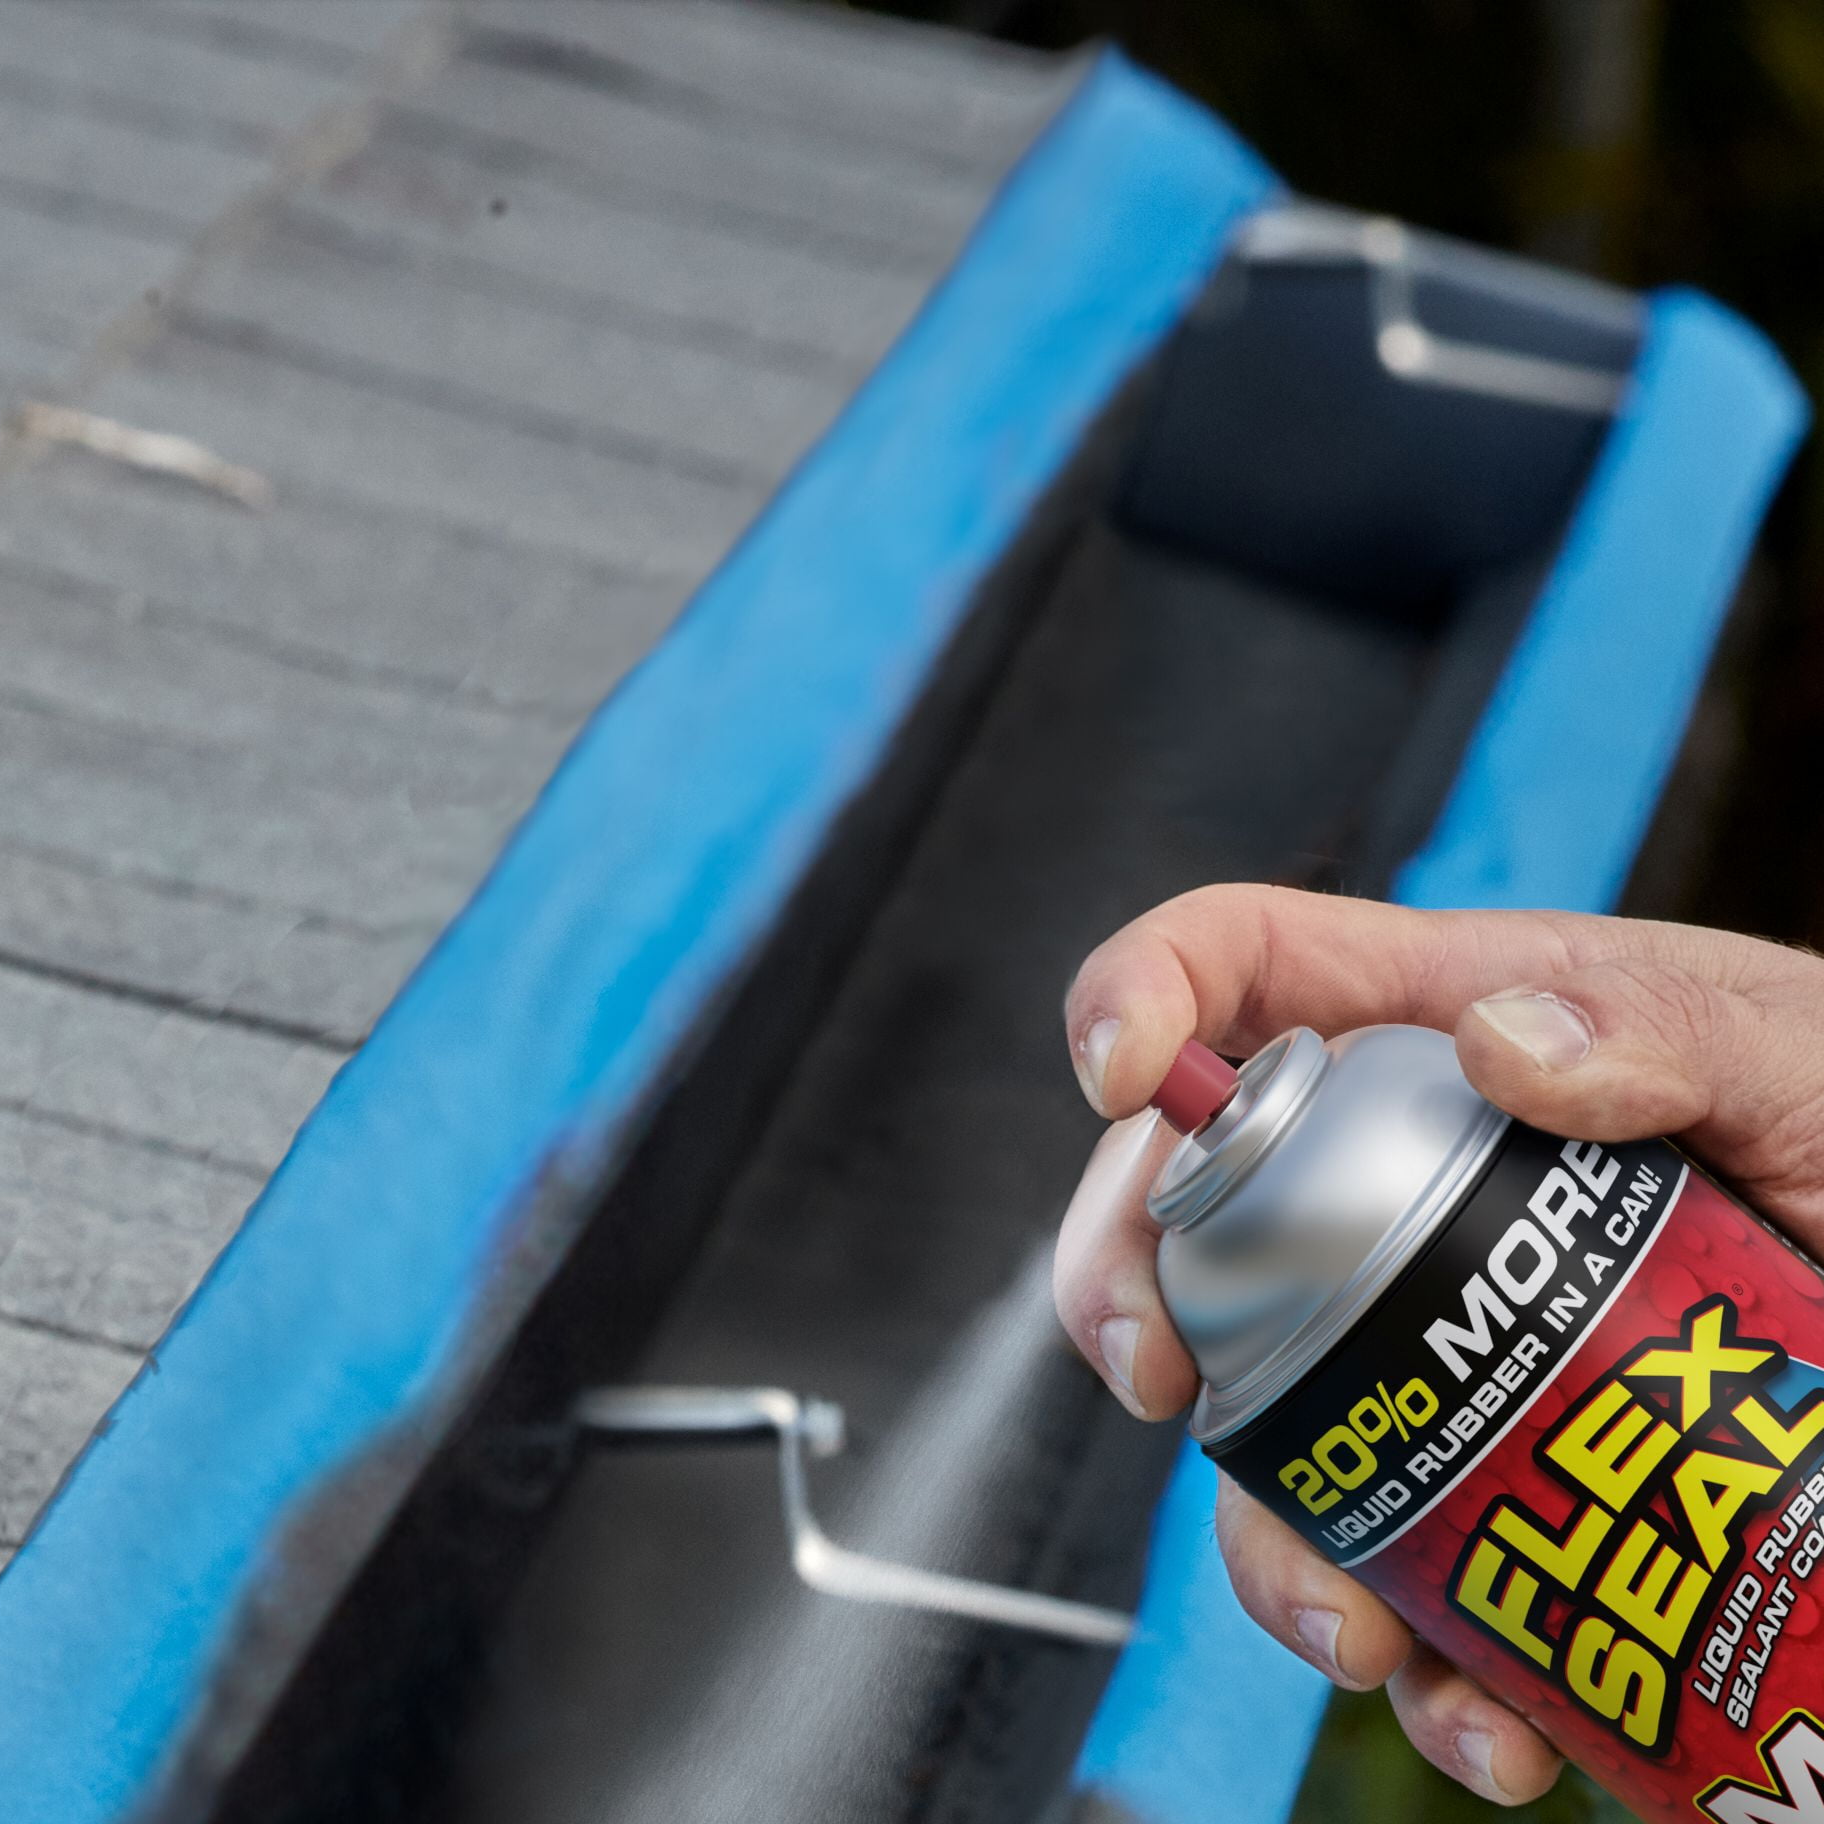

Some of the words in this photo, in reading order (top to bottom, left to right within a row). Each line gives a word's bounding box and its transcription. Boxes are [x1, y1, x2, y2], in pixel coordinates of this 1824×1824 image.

[1278, 1376, 1440, 1516] 20%
[1422, 1139, 1622, 1383] MORE
[1320, 1478, 1413, 1549] LIQUID
[1404, 1332, 1551, 1485] RUBBER
[1541, 1281, 1588, 1333] IN
[1582, 1252, 1616, 1286] A
[1604, 1163, 1664, 1247] CAN!
[1454, 1302, 1778, 1673] FLEX
[1692, 1573, 1764, 1704] LIQUID
[1726, 1577, 1797, 1729] SEALANT
